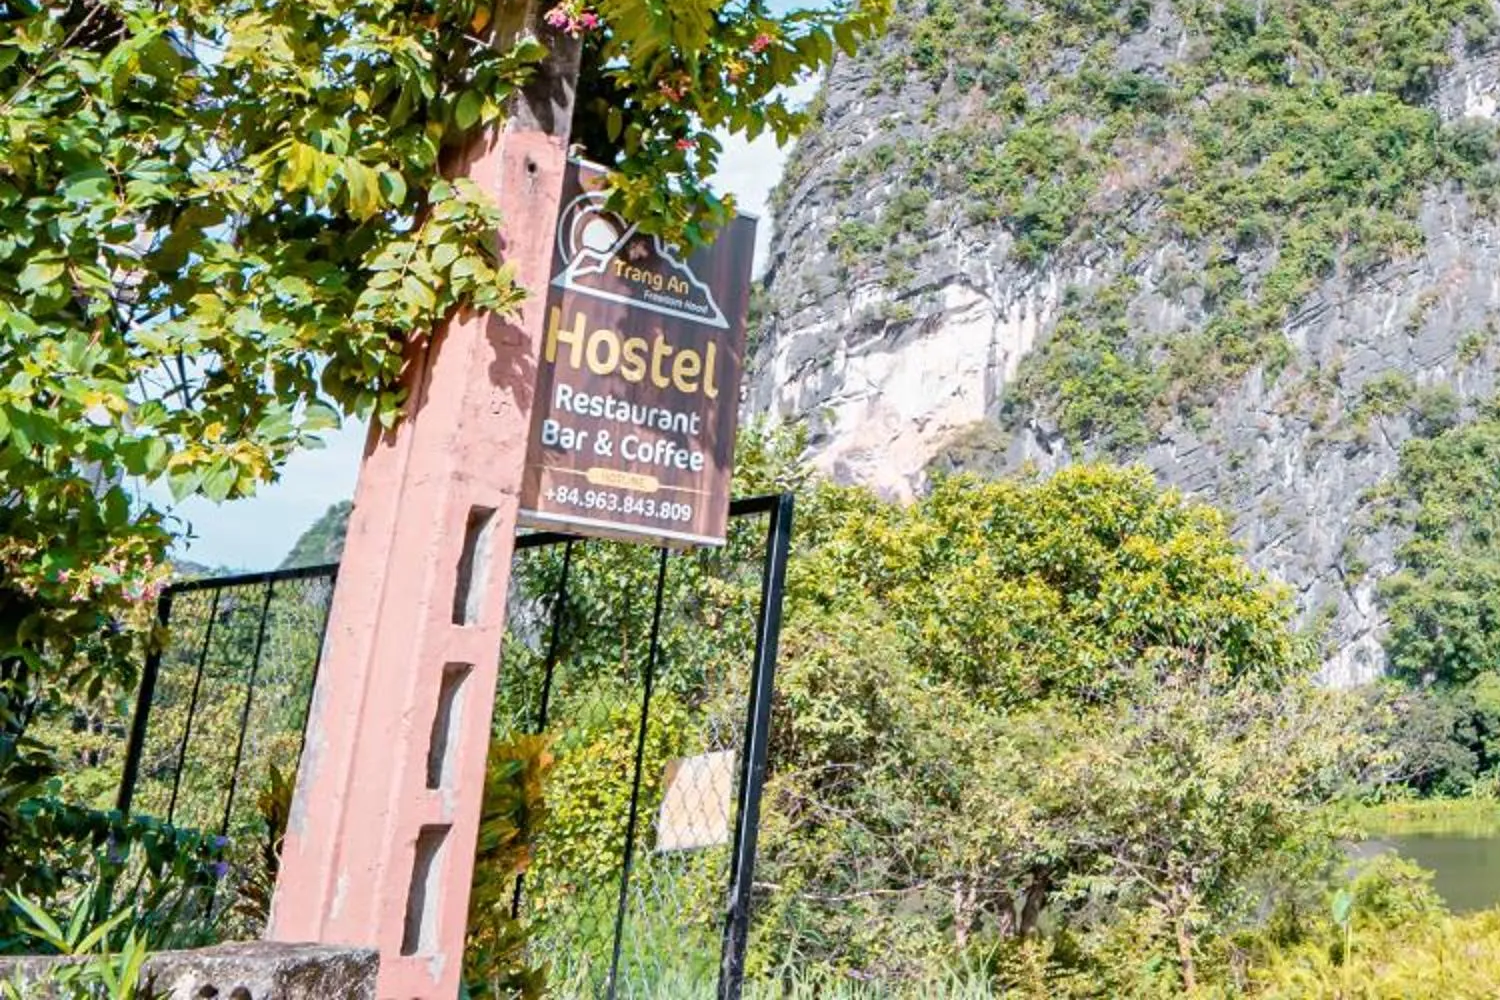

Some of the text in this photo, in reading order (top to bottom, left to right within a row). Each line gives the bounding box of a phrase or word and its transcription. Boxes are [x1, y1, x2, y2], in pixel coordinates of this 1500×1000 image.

[614, 259, 689, 295] Trang An
[545, 306, 719, 399] Hostel
[555, 383, 700, 435] Restaurant
[541, 419, 704, 471] Bar & Coffee
[545, 486, 692, 521] +84.963.843.809
